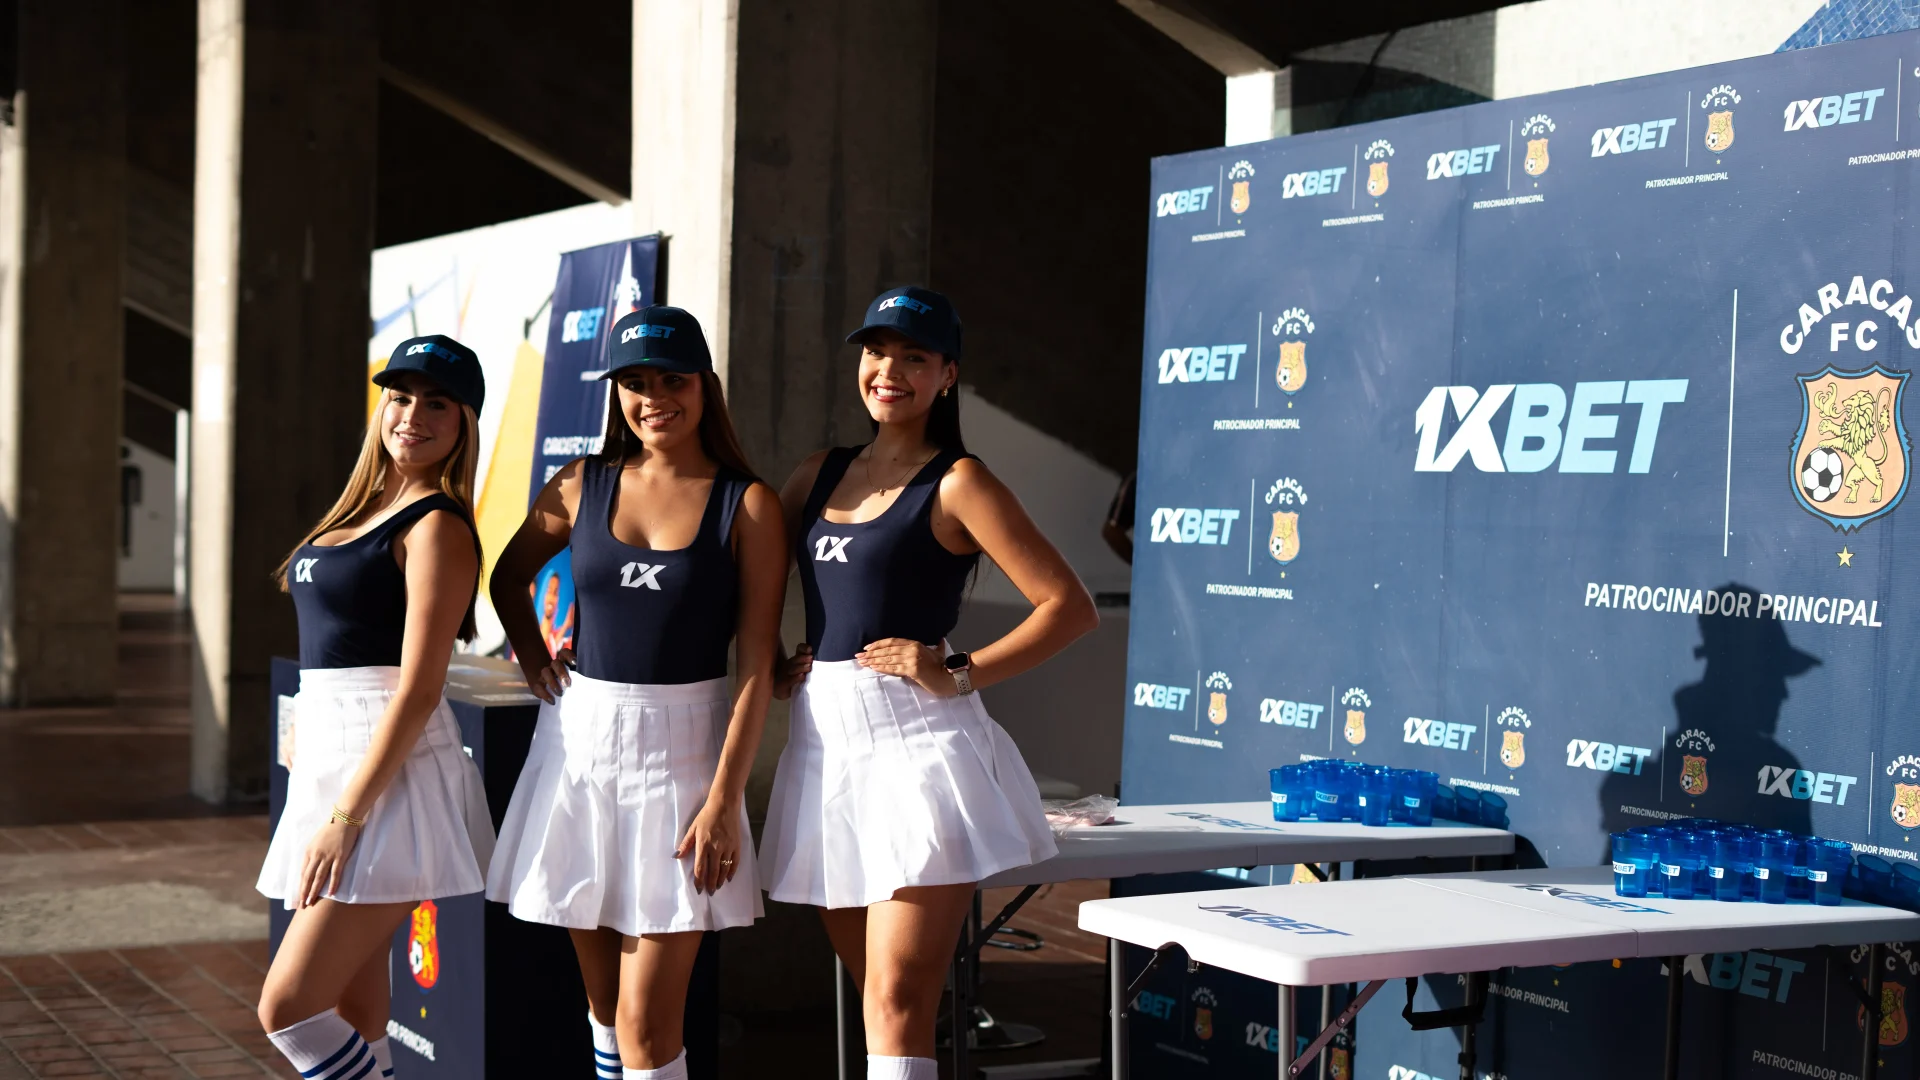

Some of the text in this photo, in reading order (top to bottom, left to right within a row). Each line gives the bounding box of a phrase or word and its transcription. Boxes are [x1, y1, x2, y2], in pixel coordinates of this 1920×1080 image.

[1701, 84, 1741, 109] CARACAS
[1714, 96, 1728, 107] FC
[1784, 88, 1885, 132] 1XBET
[1521, 113, 1556, 136] CARACAS
[1532, 125, 1545, 135] FC
[1591, 118, 1677, 158] 1XBET
[1427, 144, 1501, 181] 1XBET
[1848, 150, 1906, 166] PATROCINADOR
[1282, 166, 1348, 199] 1XBET
[1645, 172, 1729, 189] PATROCINADOR PRINCIPAL
[1157, 186, 1214, 218] 1XBET
[878, 295, 933, 315] 1XBET
[1779, 275, 1920, 355] CARACAS
[621, 324, 675, 344] 1XBET
[1272, 307, 1315, 336] CARACAS
[1286, 322, 1301, 335] FC
[1830, 320, 1879, 352] FC
[1158, 344, 1247, 384] 1XBET
[1213, 419, 1300, 431] PATROCINADOR PRINCIPAL
[1414, 378, 1690, 474] 1XBET
[1265, 477, 1308, 506] CARACAS
[1279, 493, 1294, 504] FC
[1150, 507, 1240, 545] 1XBET
[815, 535, 854, 563] 1X
[295, 558, 319, 583] 1X
[620, 562, 668, 591] 1X
[1206, 584, 1293, 600] PATROCINADOR PRINCIPAL
[1584, 582, 1883, 628] PATROCINADOR PRINCIPAL
[1134, 682, 1191, 711] 1XBET
[1260, 698, 1325, 729] 1XBET
[1497, 706, 1532, 728] CARACAS
[1508, 717, 1520, 727] FC
[1403, 717, 1477, 751] 1XBET
[1675, 728, 1716, 752] CARACAS
[1688, 740, 1702, 751] FC
[1566, 738, 1652, 776] 1XBET
[1886, 754, 1920, 777] CARAC
[1758, 765, 1857, 806] 1XBET
[1901, 767, 1918, 779] FC
[1620, 805, 1669, 821] PATROCINADOR
[1878, 846, 1919, 862] PRINCIPAL
[1613, 864, 1634, 873] XBET
[1850, 942, 1920, 976] CACAS
[1660, 952, 1807, 1004] XBET
[1523, 991, 1570, 1013] PRINCIPAL
[1245, 1021, 1310, 1059] 1XBT
[1752, 1050, 1837, 1080] PATROCINADOR
